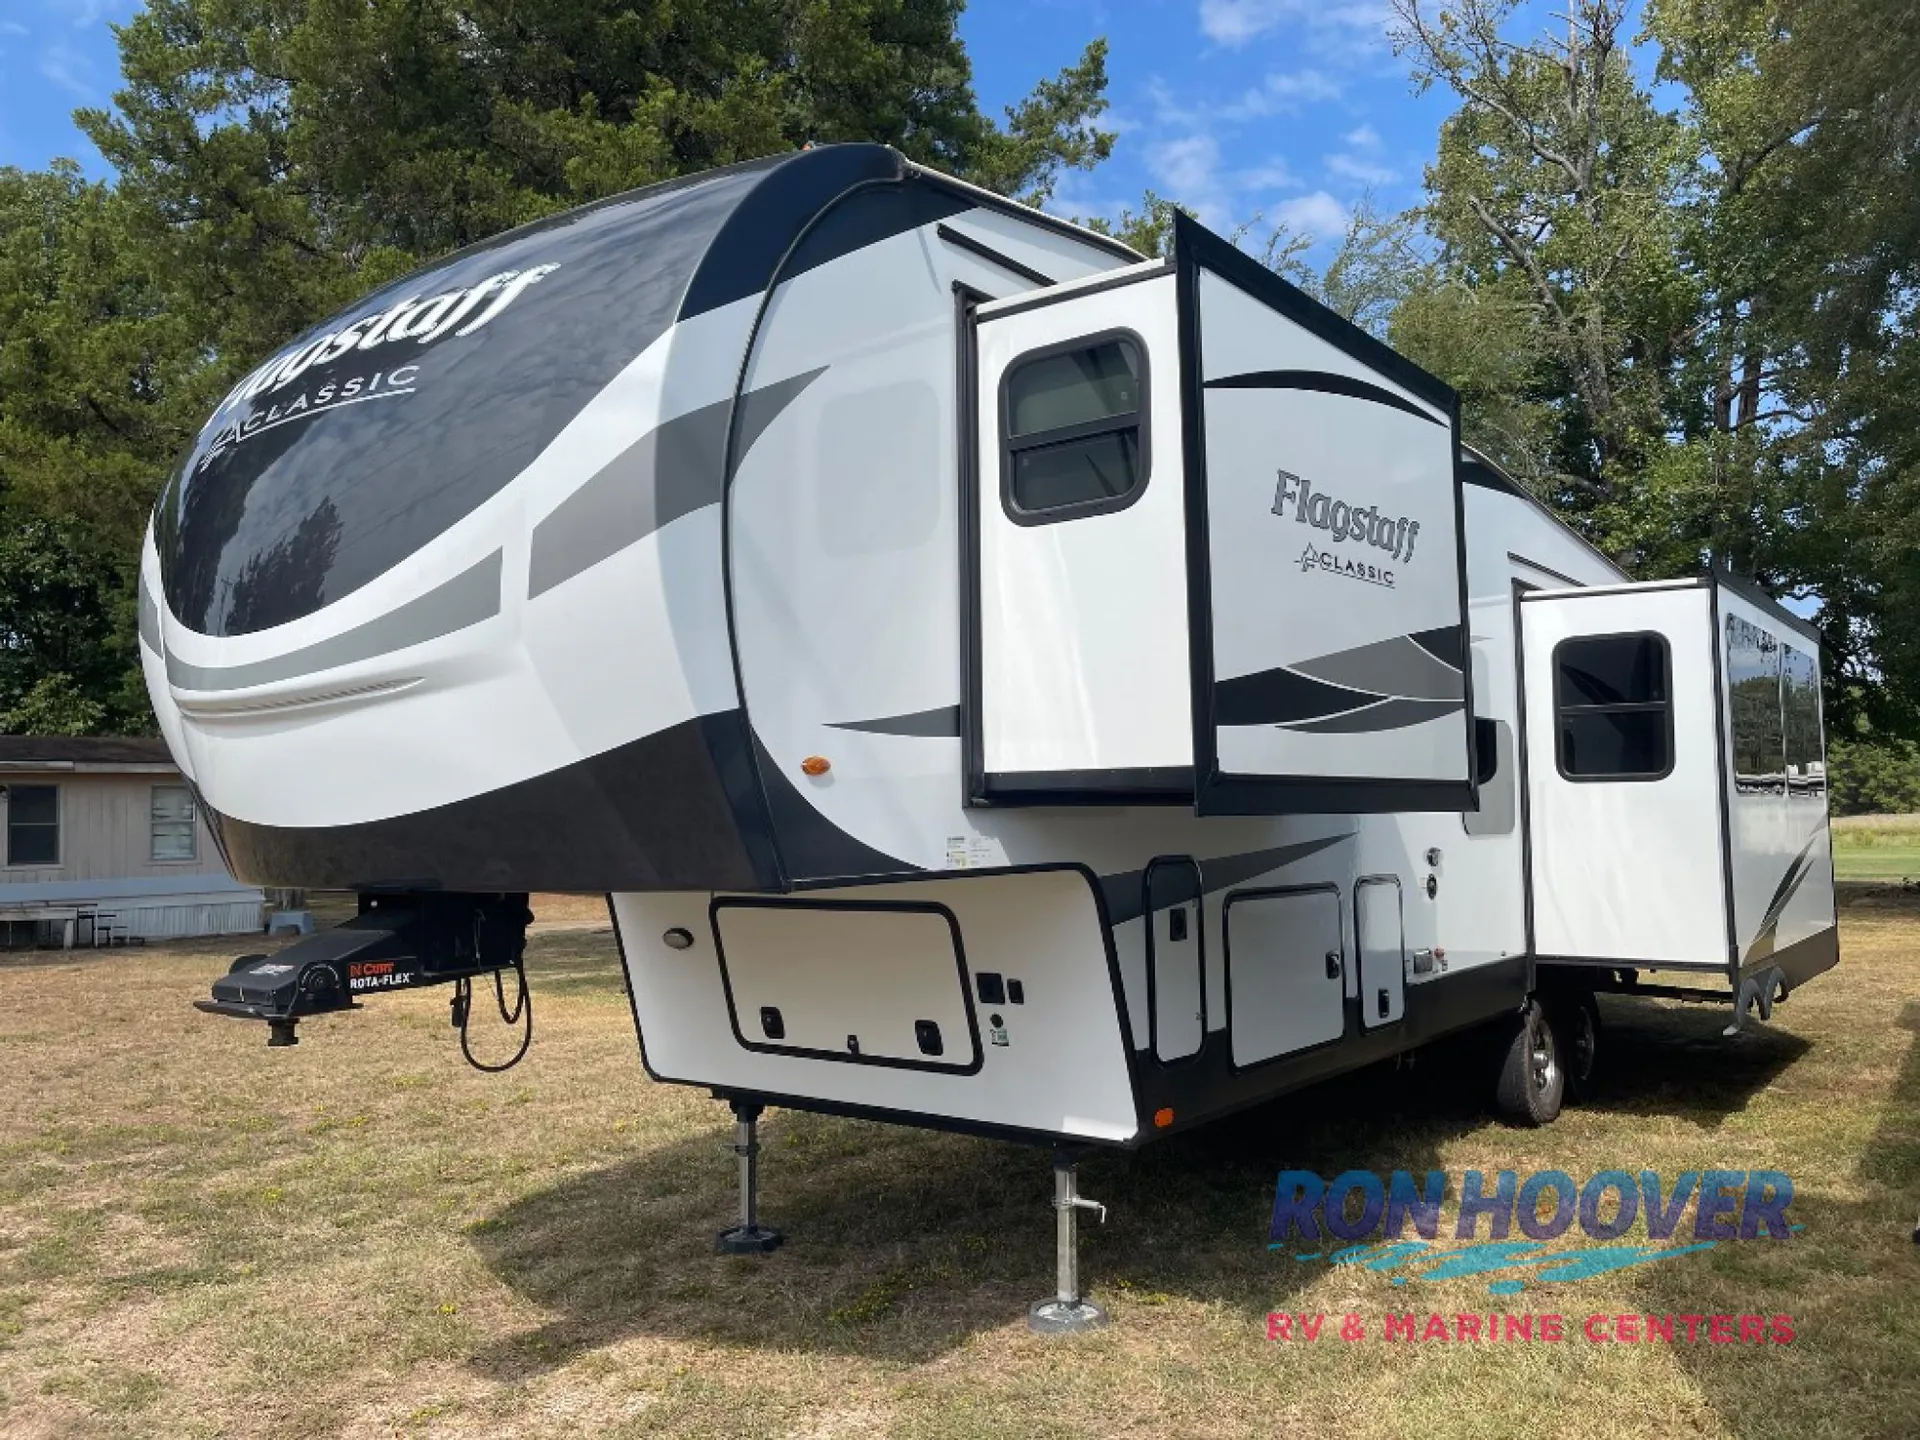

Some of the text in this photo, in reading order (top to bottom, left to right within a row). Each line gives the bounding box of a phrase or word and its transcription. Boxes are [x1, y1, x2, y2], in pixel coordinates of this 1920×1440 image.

[243, 365, 420, 432] CLASSIC
[1271, 468, 1420, 564] Flagstaff
[1320, 552, 1395, 585] CLASSIC
[350, 972, 410, 989] ROTA-FLEX
